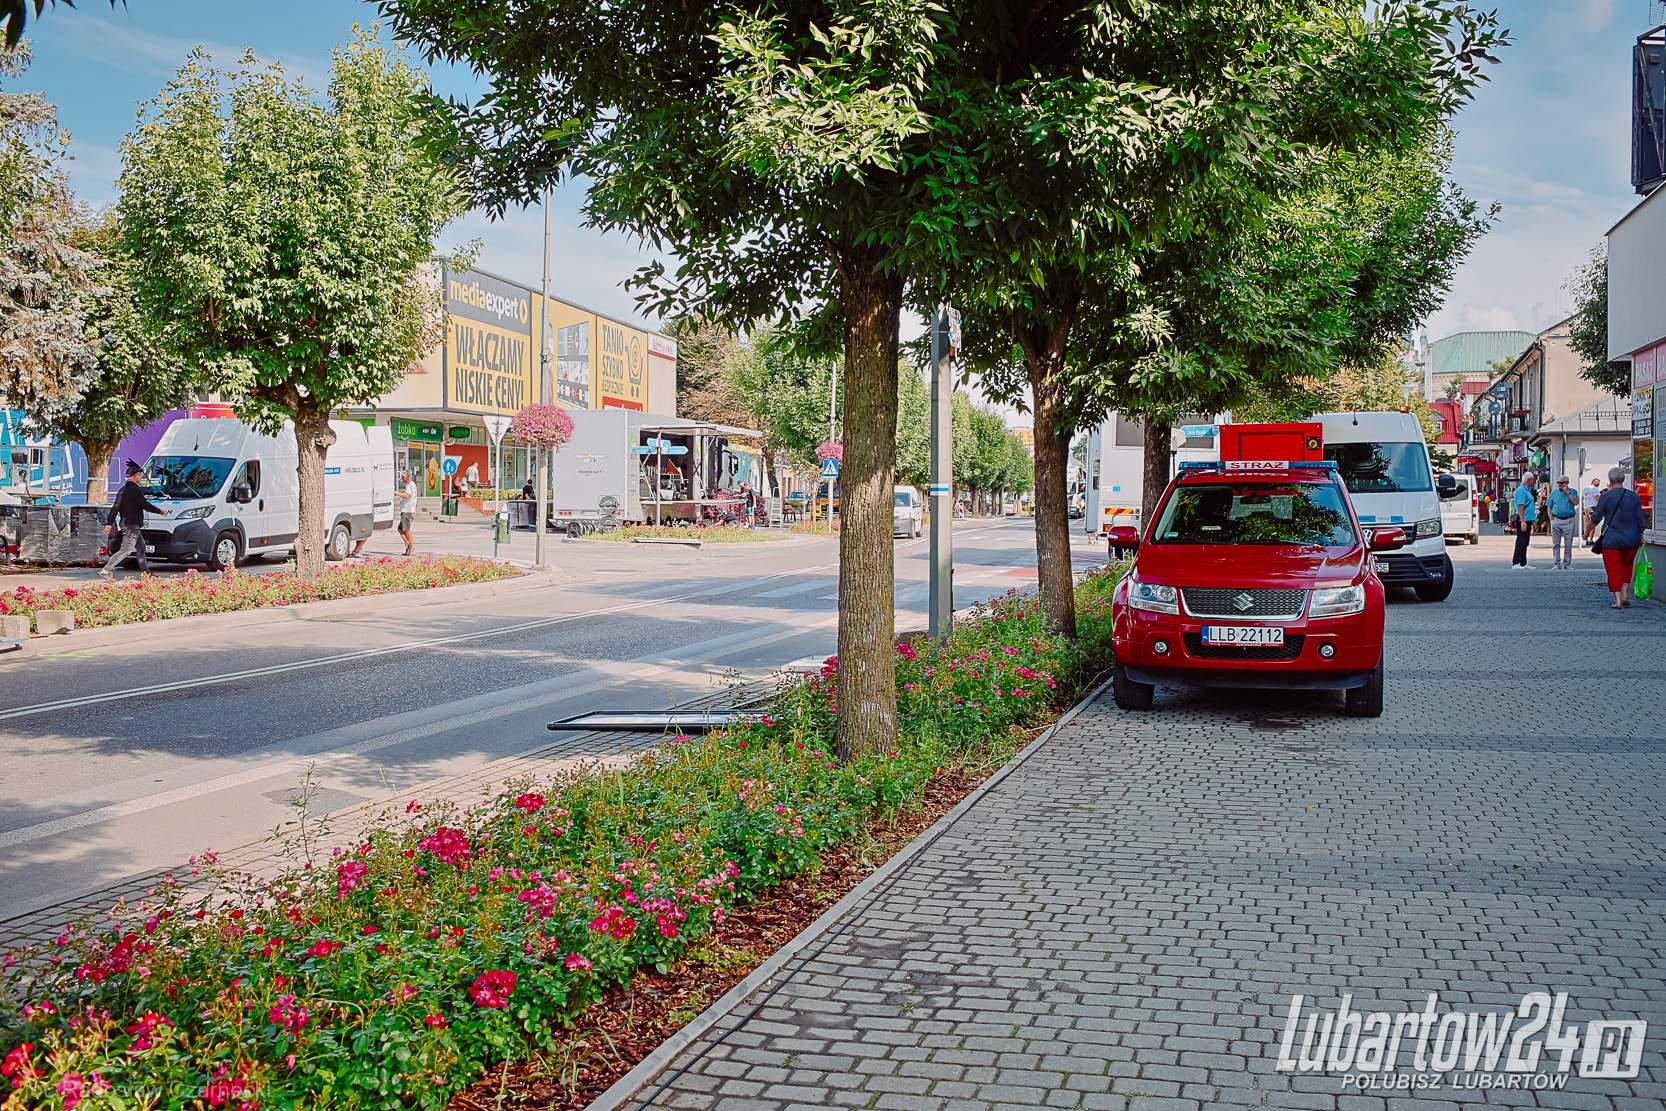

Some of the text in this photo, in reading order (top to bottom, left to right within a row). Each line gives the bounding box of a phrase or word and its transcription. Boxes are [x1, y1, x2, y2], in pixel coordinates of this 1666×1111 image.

[450, 280, 519, 319] mediaexpert
[455, 323, 524, 376] WŁĄCZAMY
[603, 325, 623, 356] TANIO
[603, 354, 623, 380] SZYBKO
[455, 367, 524, 410] NISKIE CENY!
[1209, 628, 1236, 641] LLB
[1240, 628, 1282, 642] 22112
